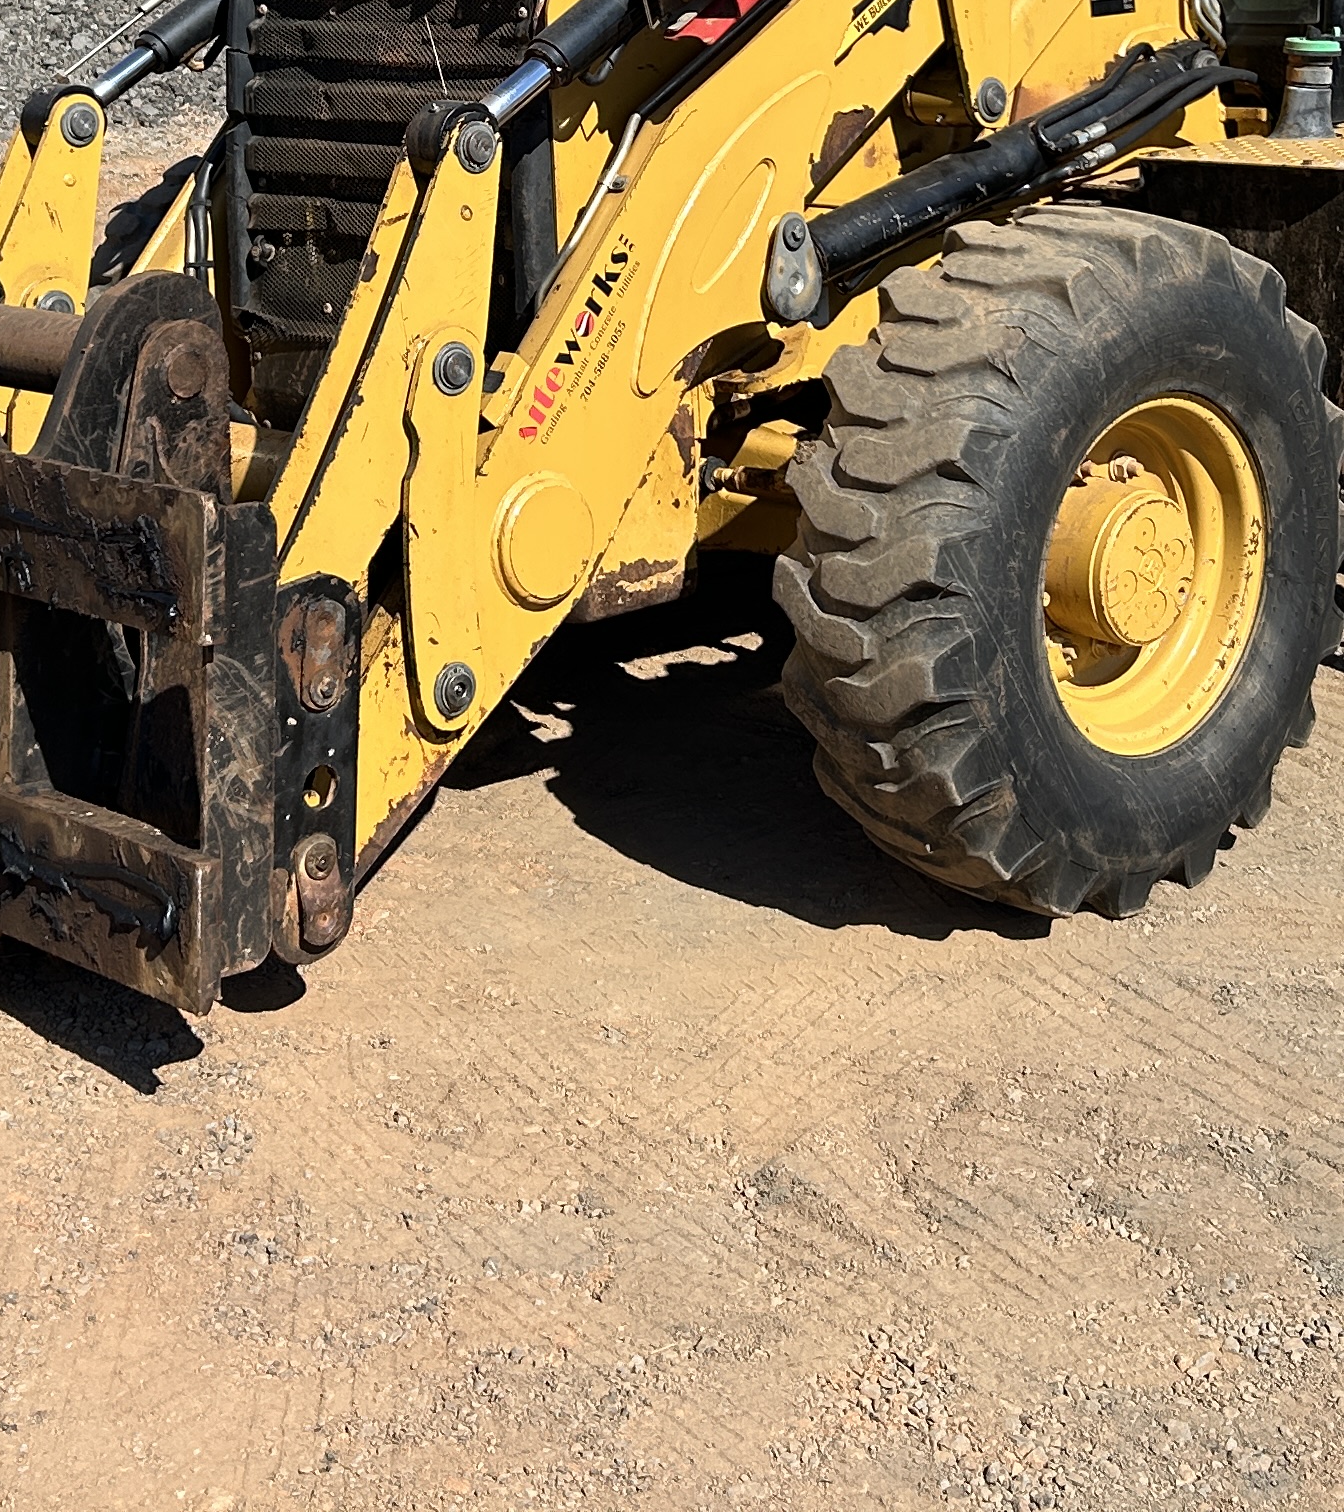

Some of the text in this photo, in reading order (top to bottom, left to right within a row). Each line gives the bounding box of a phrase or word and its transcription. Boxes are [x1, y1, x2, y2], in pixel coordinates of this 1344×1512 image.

[853, 13, 870, 33] WE
[540, 260, 641, 445] Grading Asphalt Concrete Utilities
[579, 321, 627, 403] 704-588-3055
